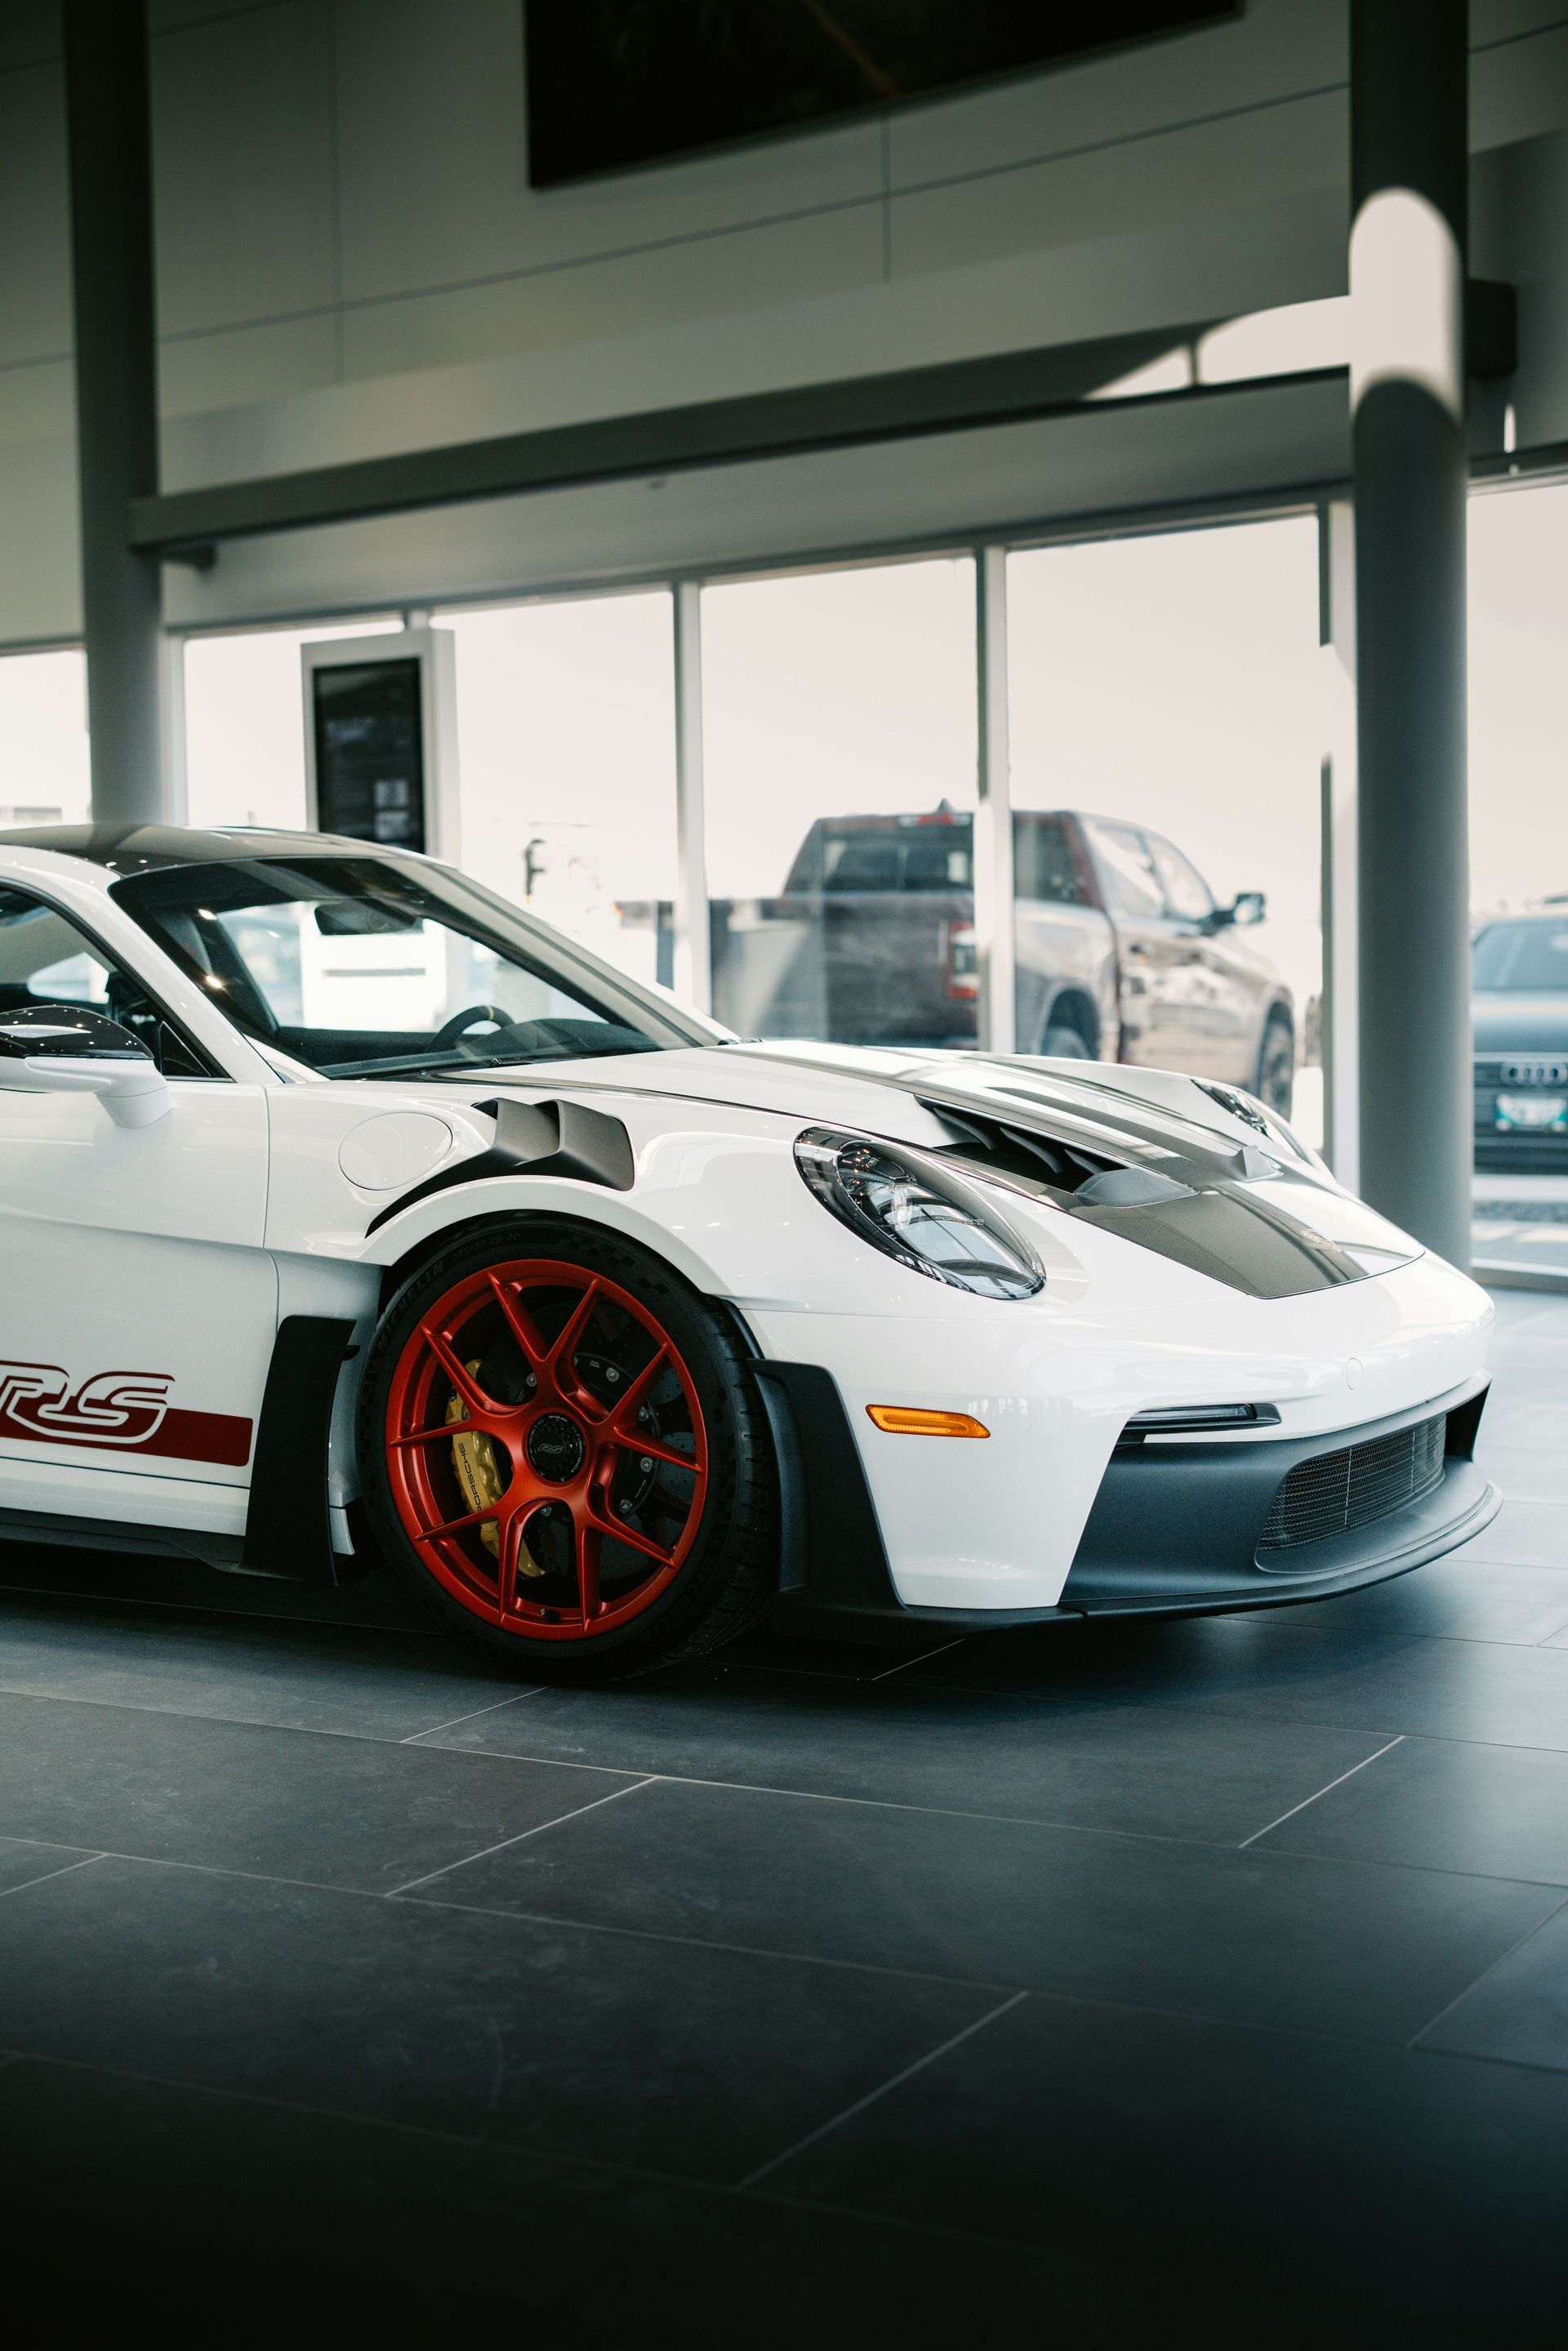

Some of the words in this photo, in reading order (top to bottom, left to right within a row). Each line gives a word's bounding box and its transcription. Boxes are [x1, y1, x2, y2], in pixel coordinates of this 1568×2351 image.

[507, 1231, 520, 1242] 20
[376, 1259, 446, 1352] MICHELIN
[0, 1360, 176, 1445] RS
[537, 1443, 564, 1454] RS
